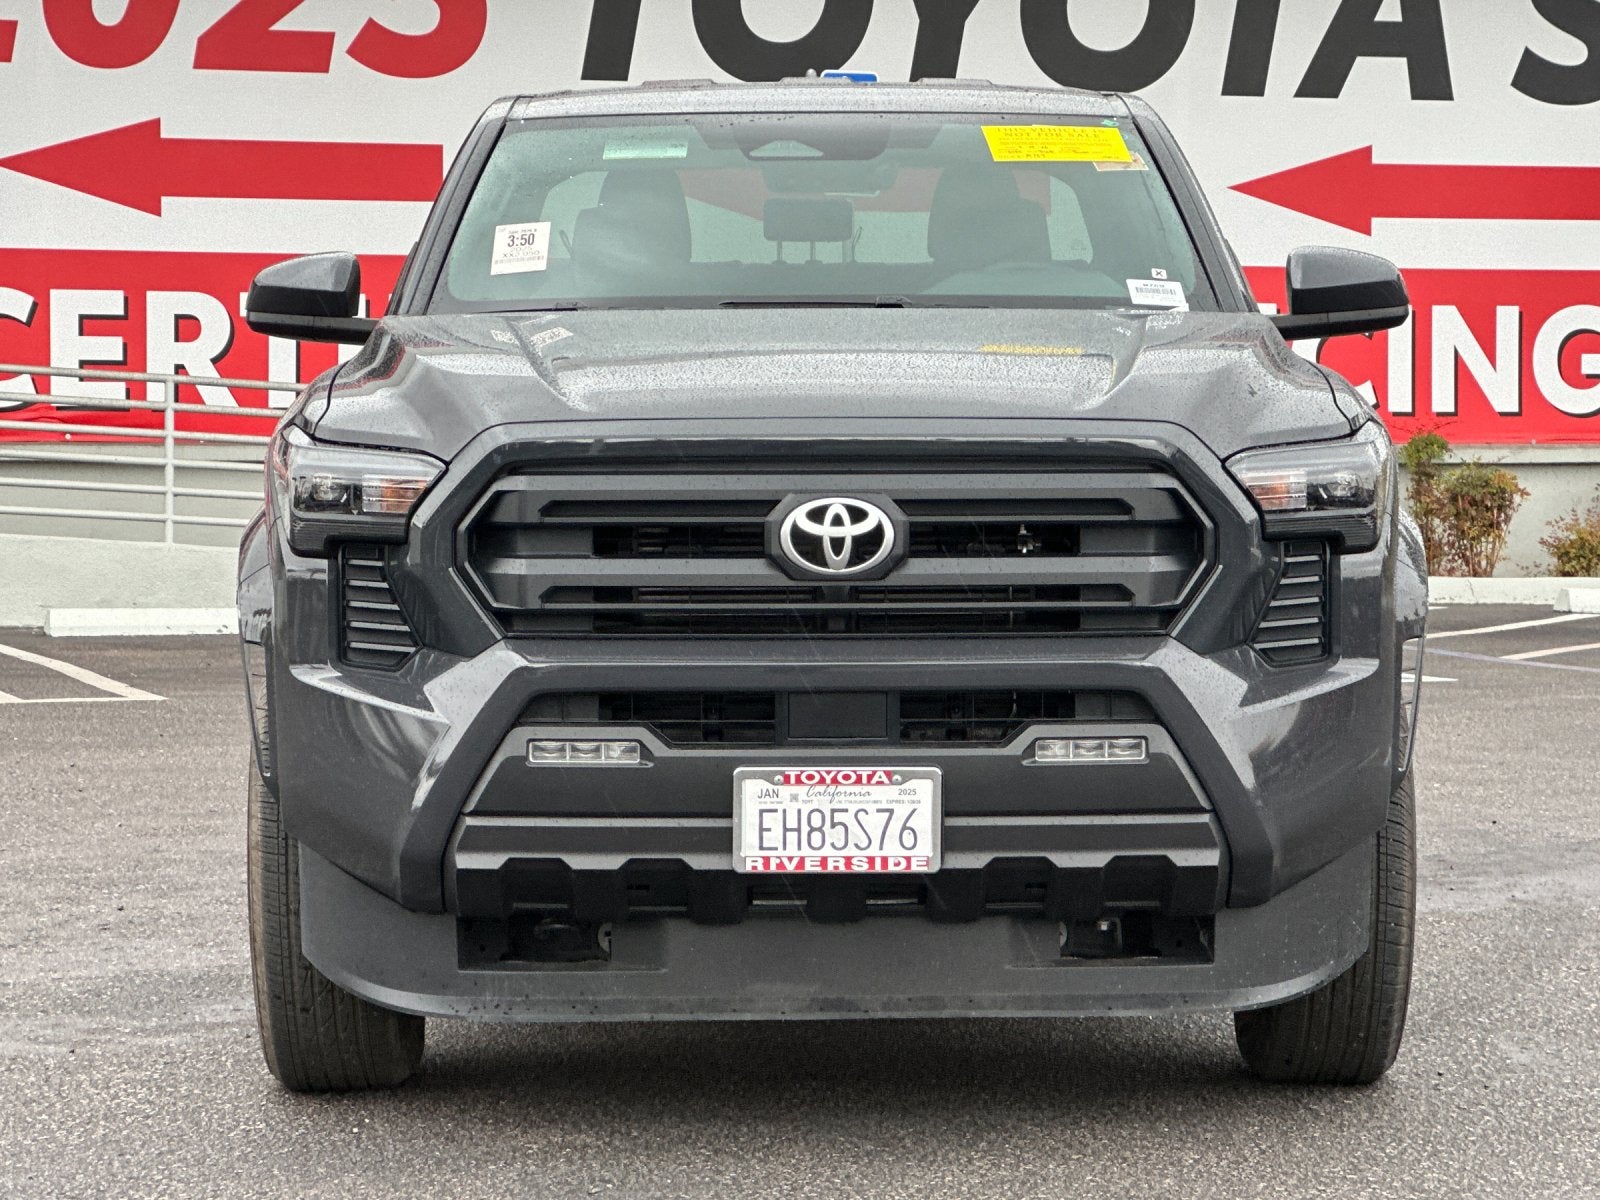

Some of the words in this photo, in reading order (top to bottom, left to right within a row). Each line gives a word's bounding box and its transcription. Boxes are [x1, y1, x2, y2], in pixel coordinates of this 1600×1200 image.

[507, 233, 535, 247] 3:50
[784, 771, 890, 785] TOYOTA
[757, 788, 780, 799] JAN
[806, 785, 872, 804] California
[898, 788, 917, 796] 2025
[758, 808, 918, 851] EH85S76
[745, 856, 929, 871] RIVERSIDE
